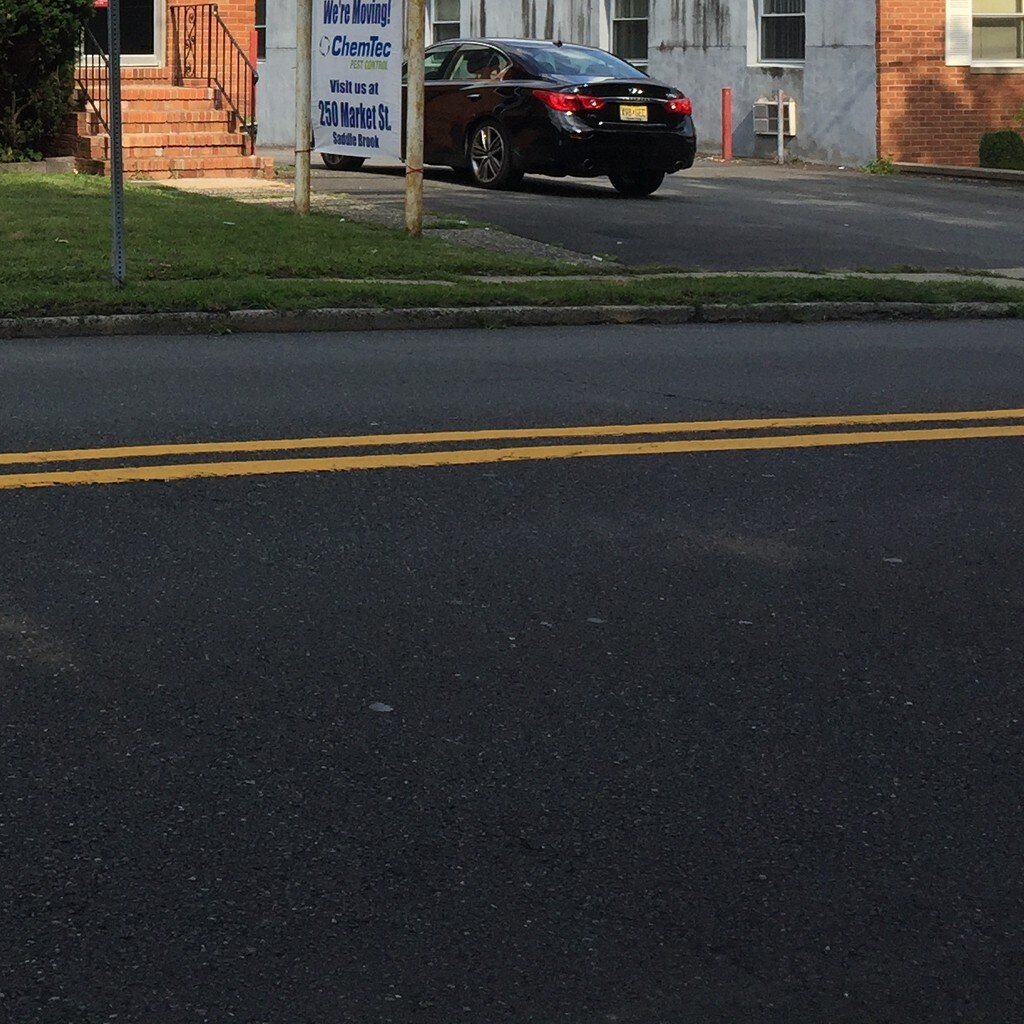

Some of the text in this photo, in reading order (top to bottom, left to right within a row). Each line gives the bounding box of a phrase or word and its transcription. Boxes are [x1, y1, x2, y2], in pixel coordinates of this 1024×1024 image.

[323, 0, 391, 27] We're Moving!
[331, 35, 391, 57] ChemTec
[349, 60, 388, 70] PEST CONTROL
[329, 80, 379, 95] Visit us at
[318, 100, 392, 131] 250 Market St.
[332, 132, 379, 148] Saddle Brook
